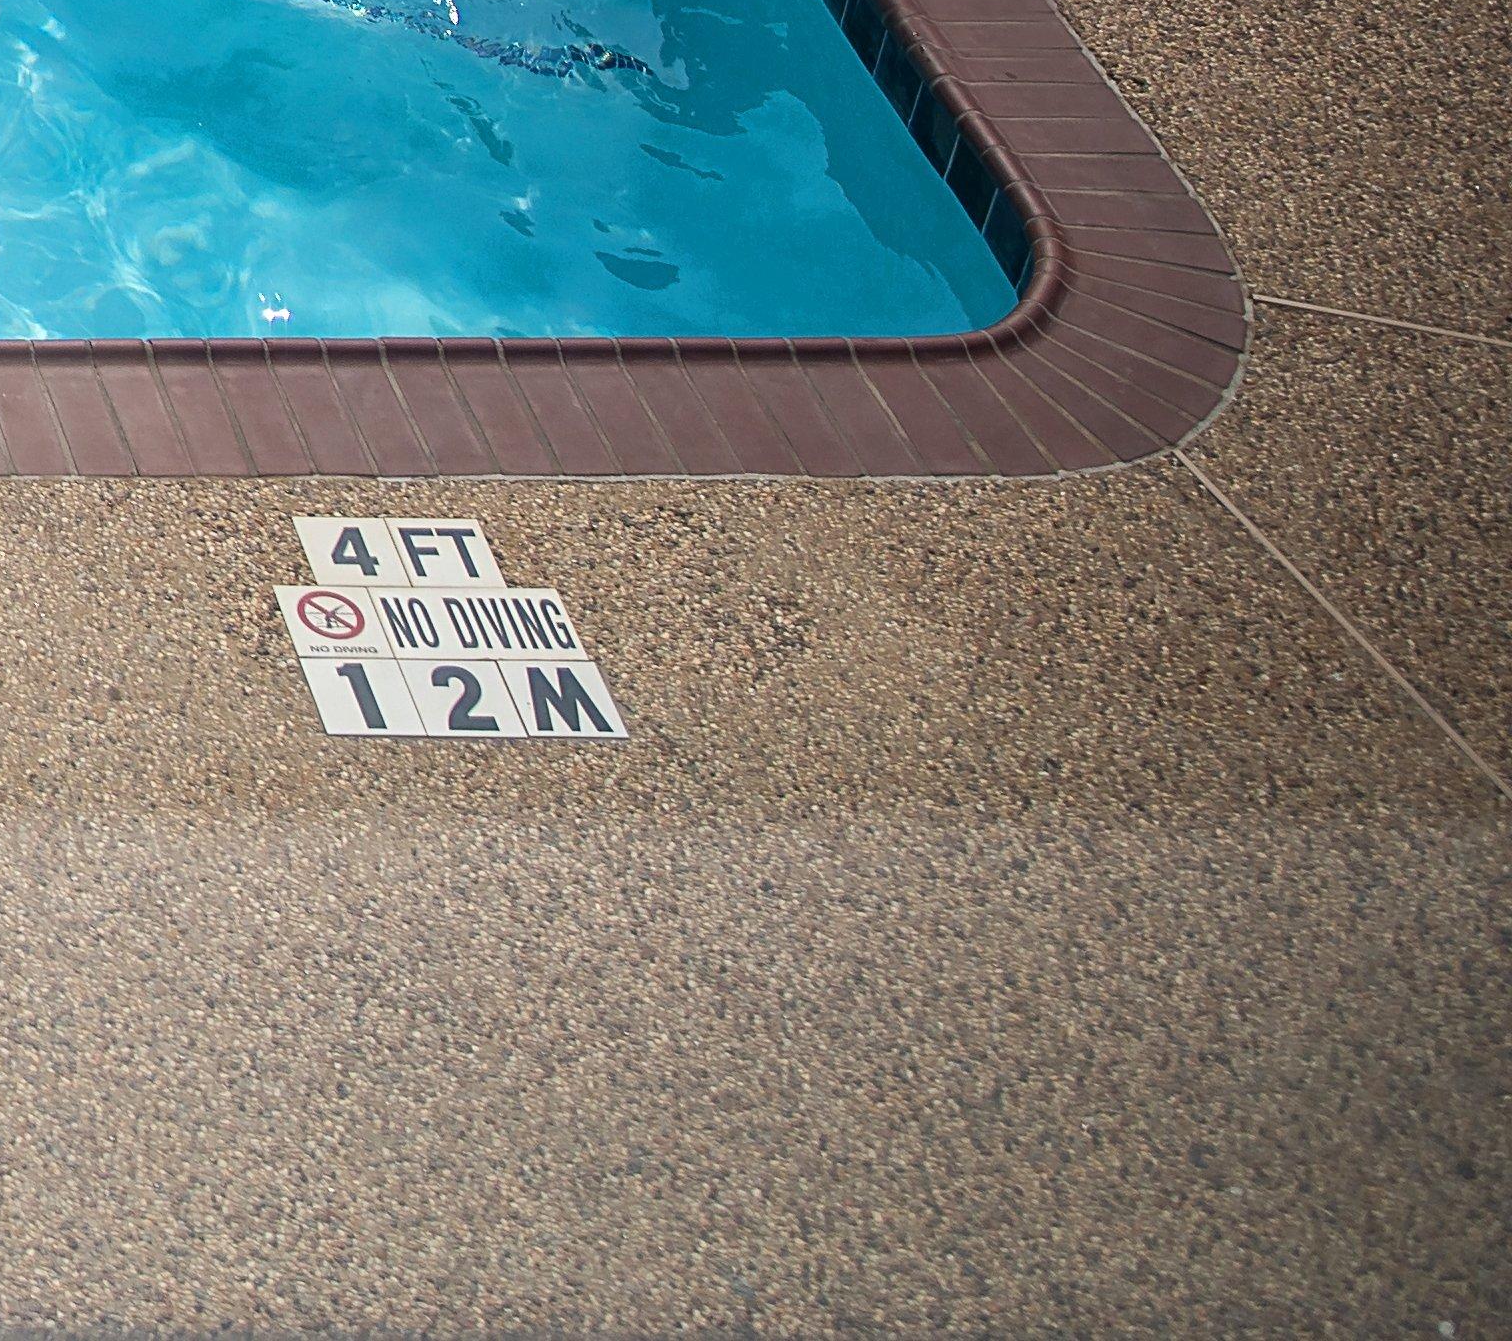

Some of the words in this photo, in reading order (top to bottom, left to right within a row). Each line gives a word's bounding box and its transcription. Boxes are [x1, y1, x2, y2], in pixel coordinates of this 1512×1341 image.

[331, 527, 379, 577] 4
[398, 528, 480, 578] FT
[333, 645, 378, 654] DIVING
[379, 597, 440, 649] NO
[442, 597, 576, 650] DIVING
[337, 663, 388, 729] 1
[431, 665, 500, 731] 2
[527, 666, 614, 733] M
